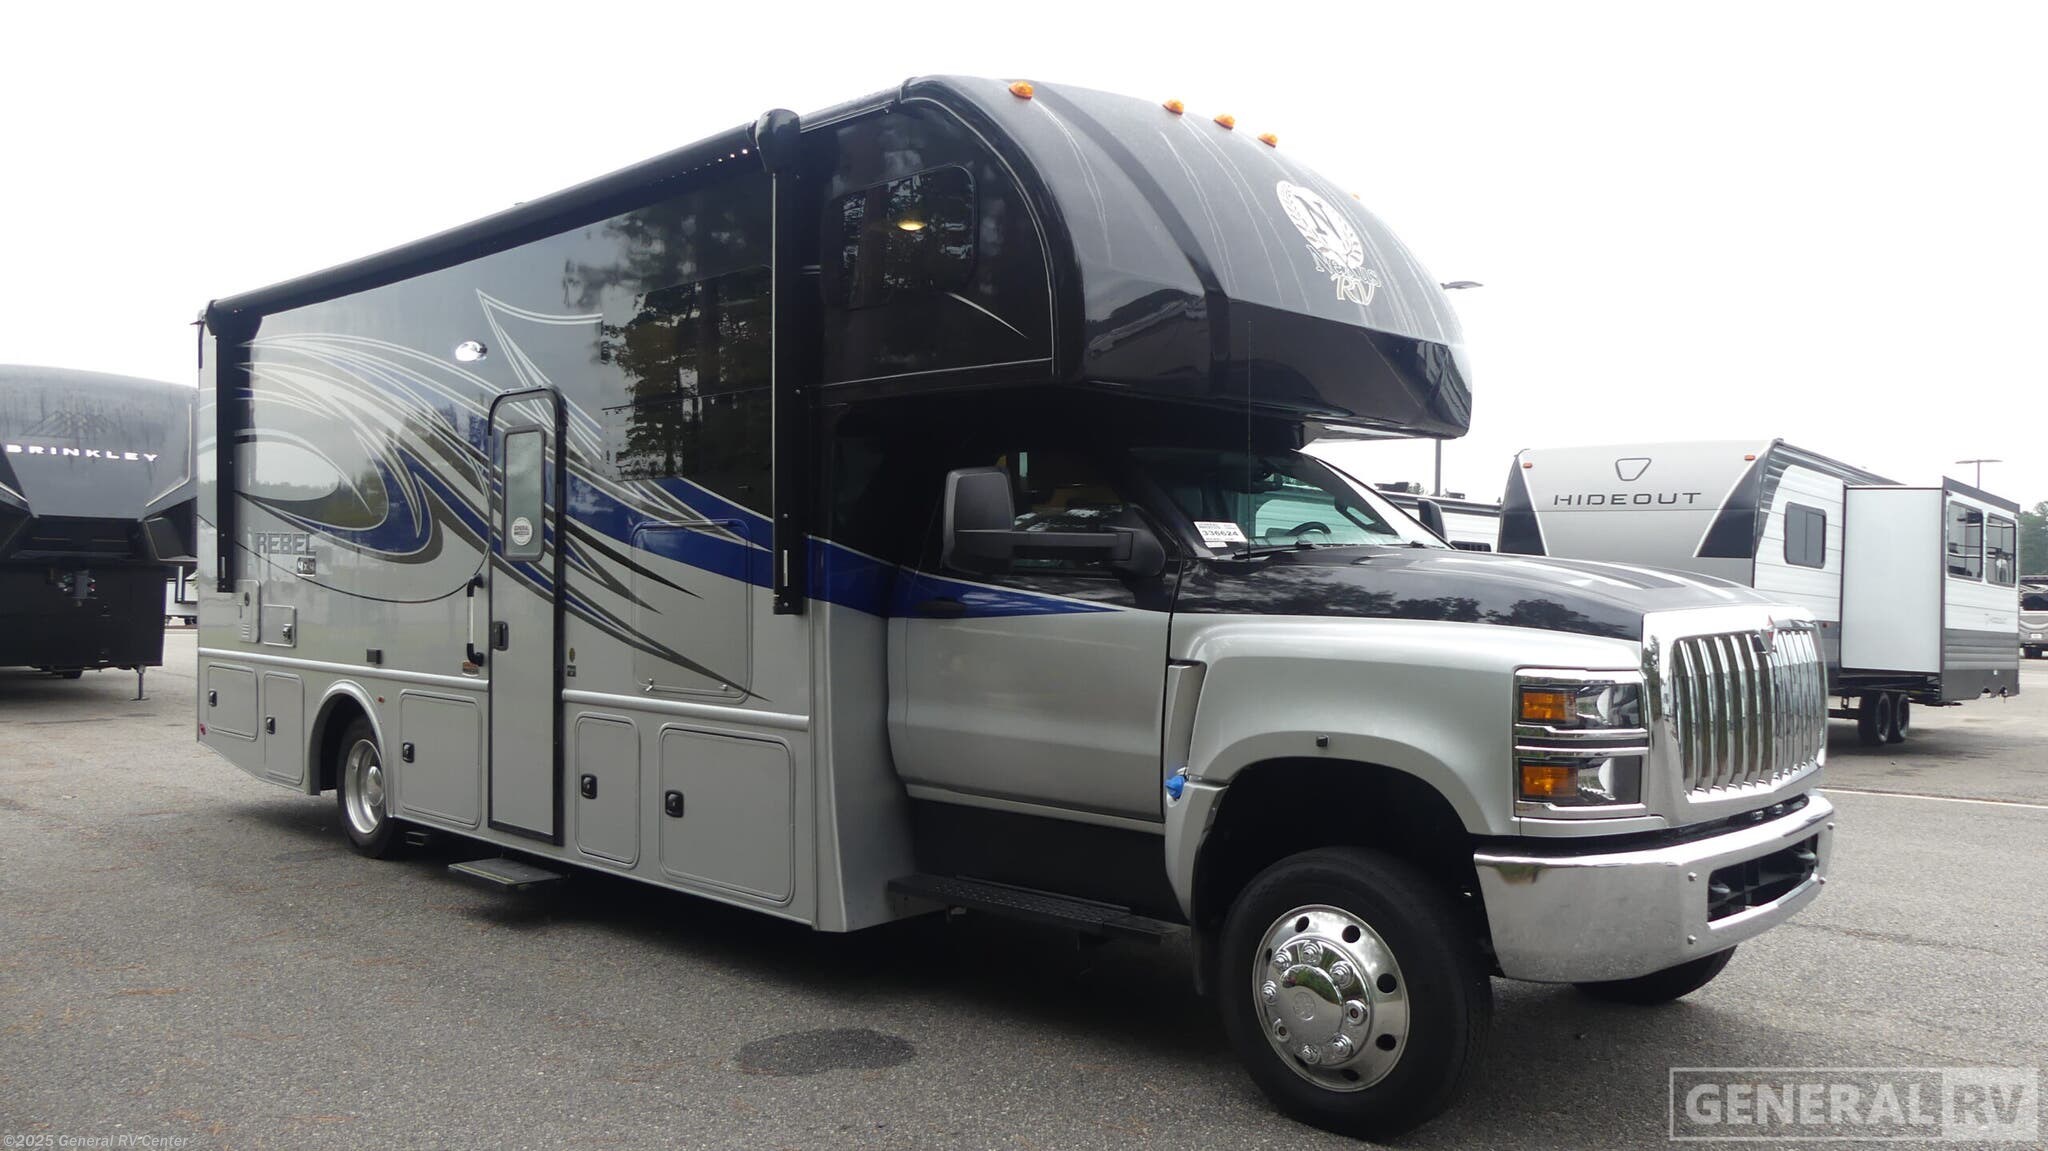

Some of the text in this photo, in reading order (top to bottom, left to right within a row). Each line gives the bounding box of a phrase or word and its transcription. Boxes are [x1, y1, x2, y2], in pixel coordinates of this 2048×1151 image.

[6, 444, 158, 462] BRINKLEY
[1553, 492, 1702, 506] HIDEOUT
[255, 532, 316, 556] REBEL
